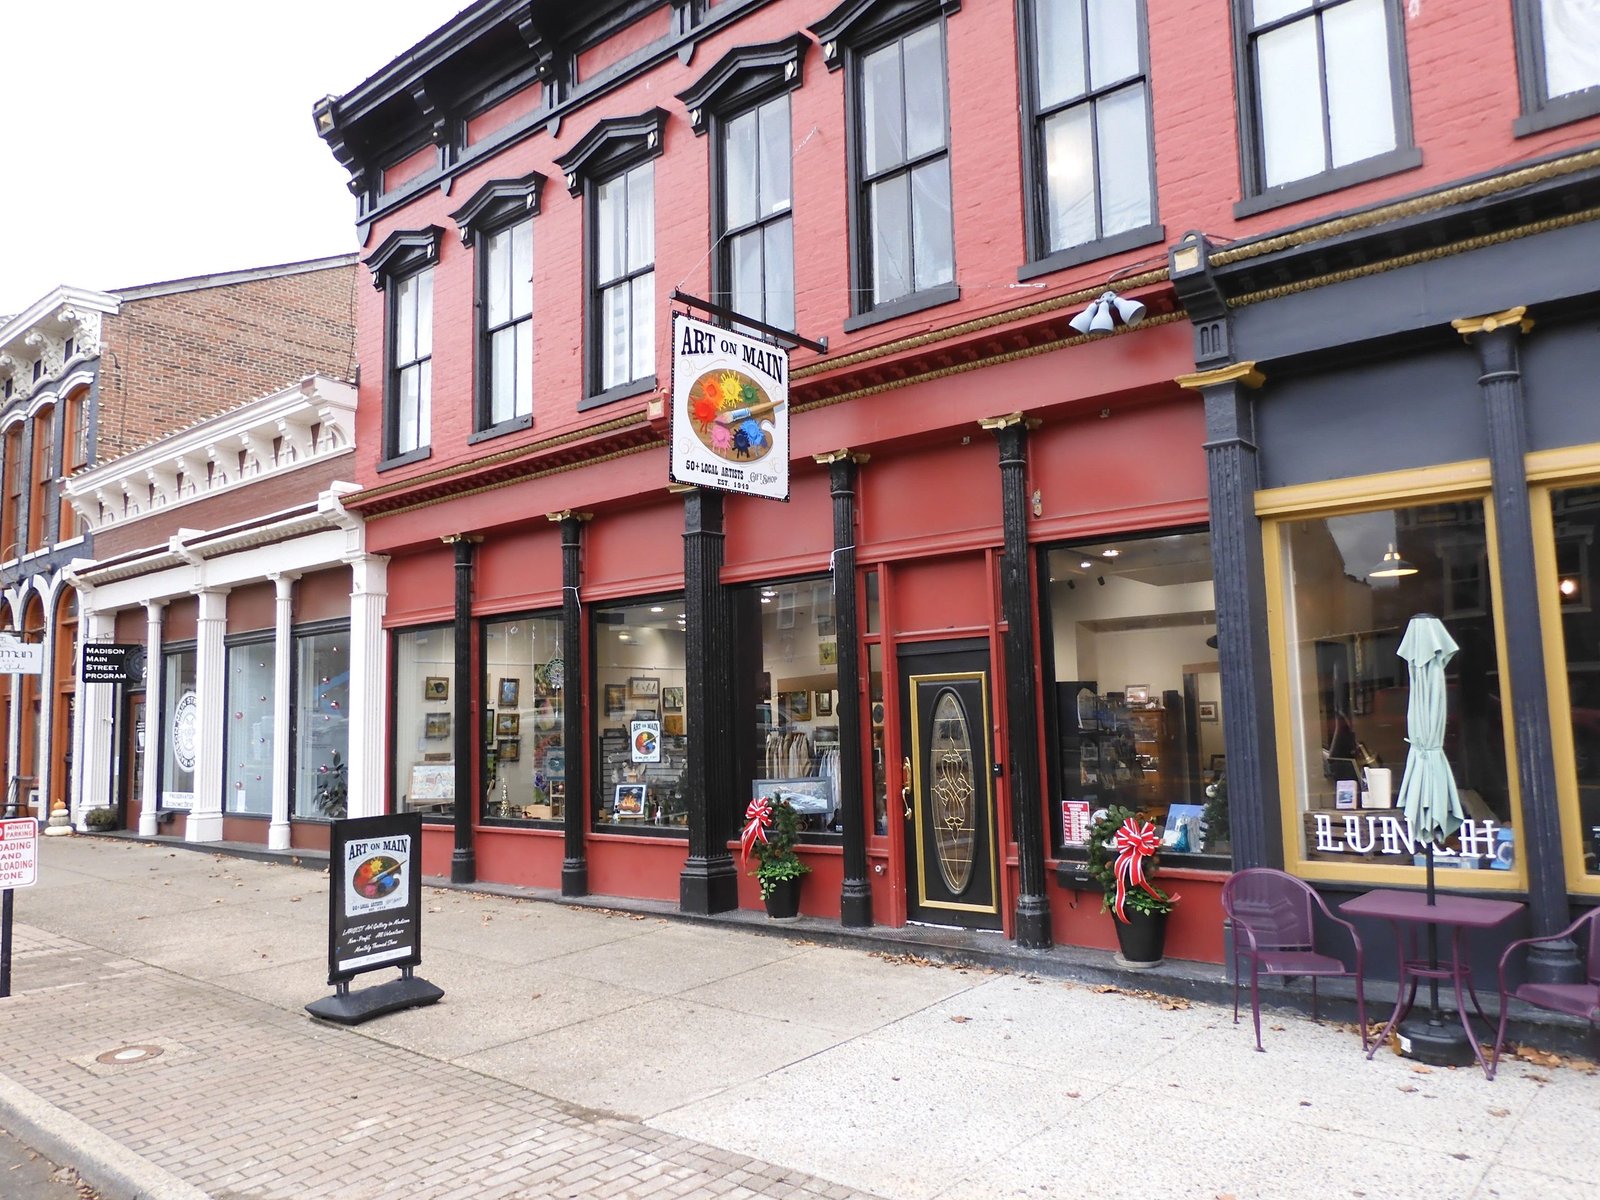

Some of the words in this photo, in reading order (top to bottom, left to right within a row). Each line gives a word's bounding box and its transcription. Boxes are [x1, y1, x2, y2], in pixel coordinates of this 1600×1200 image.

[681, 326, 715, 356] ART
[720, 340, 738, 355] ON
[742, 344, 783, 385] MAIN
[685, 460, 700, 472] 50+
[701, 462, 719, 476] LOCAL
[721, 466, 744, 480] ARTISTS
[86, 647, 125, 655] MADISON
[86, 655, 108, 663] MAIN
[1314, 814, 1496, 858] LUNH
[1, 852, 22, 861] AND
[349, 843, 368, 860] ART
[383, 839, 407, 853] MAIN
